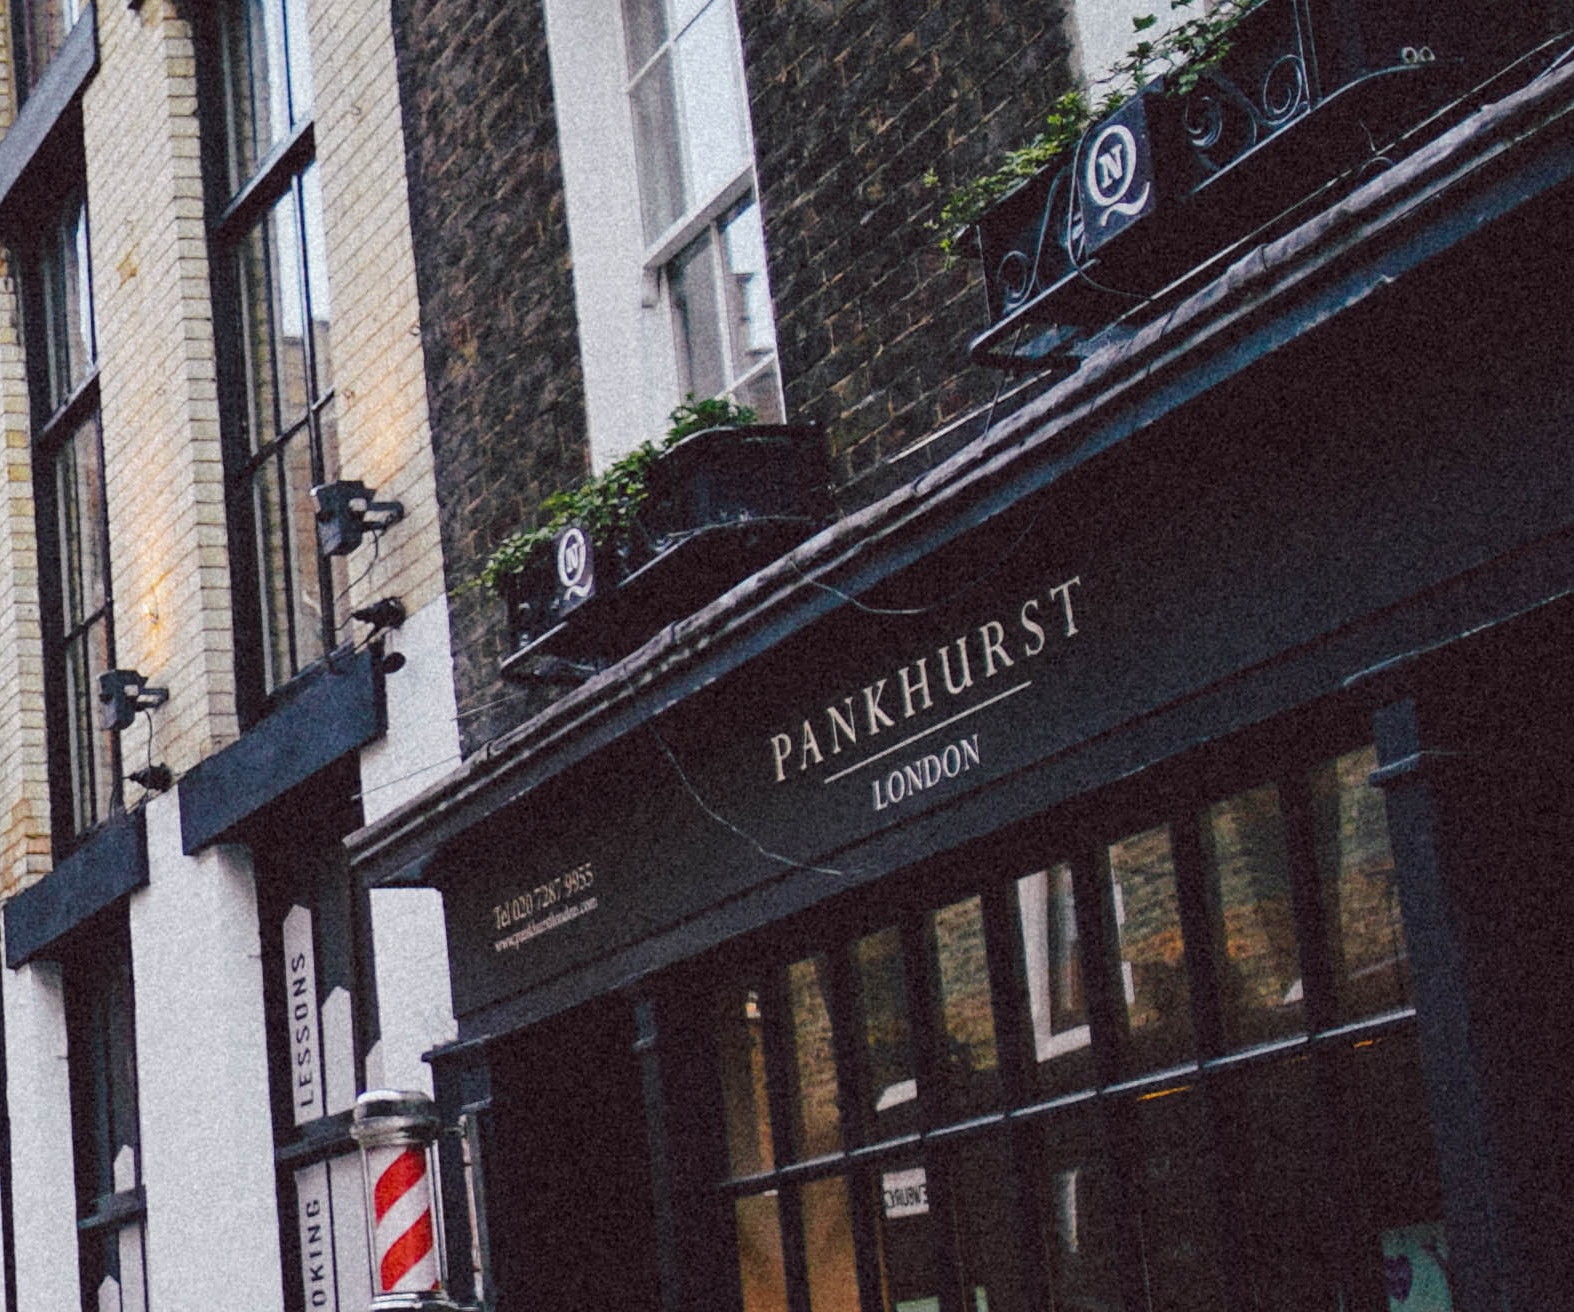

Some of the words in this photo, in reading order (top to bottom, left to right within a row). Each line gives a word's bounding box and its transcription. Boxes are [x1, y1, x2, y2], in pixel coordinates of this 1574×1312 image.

[769, 575, 1084, 782] PANKHURST
[870, 735, 981, 811] LONDON
[289, 952, 314, 1110] LESSONS
